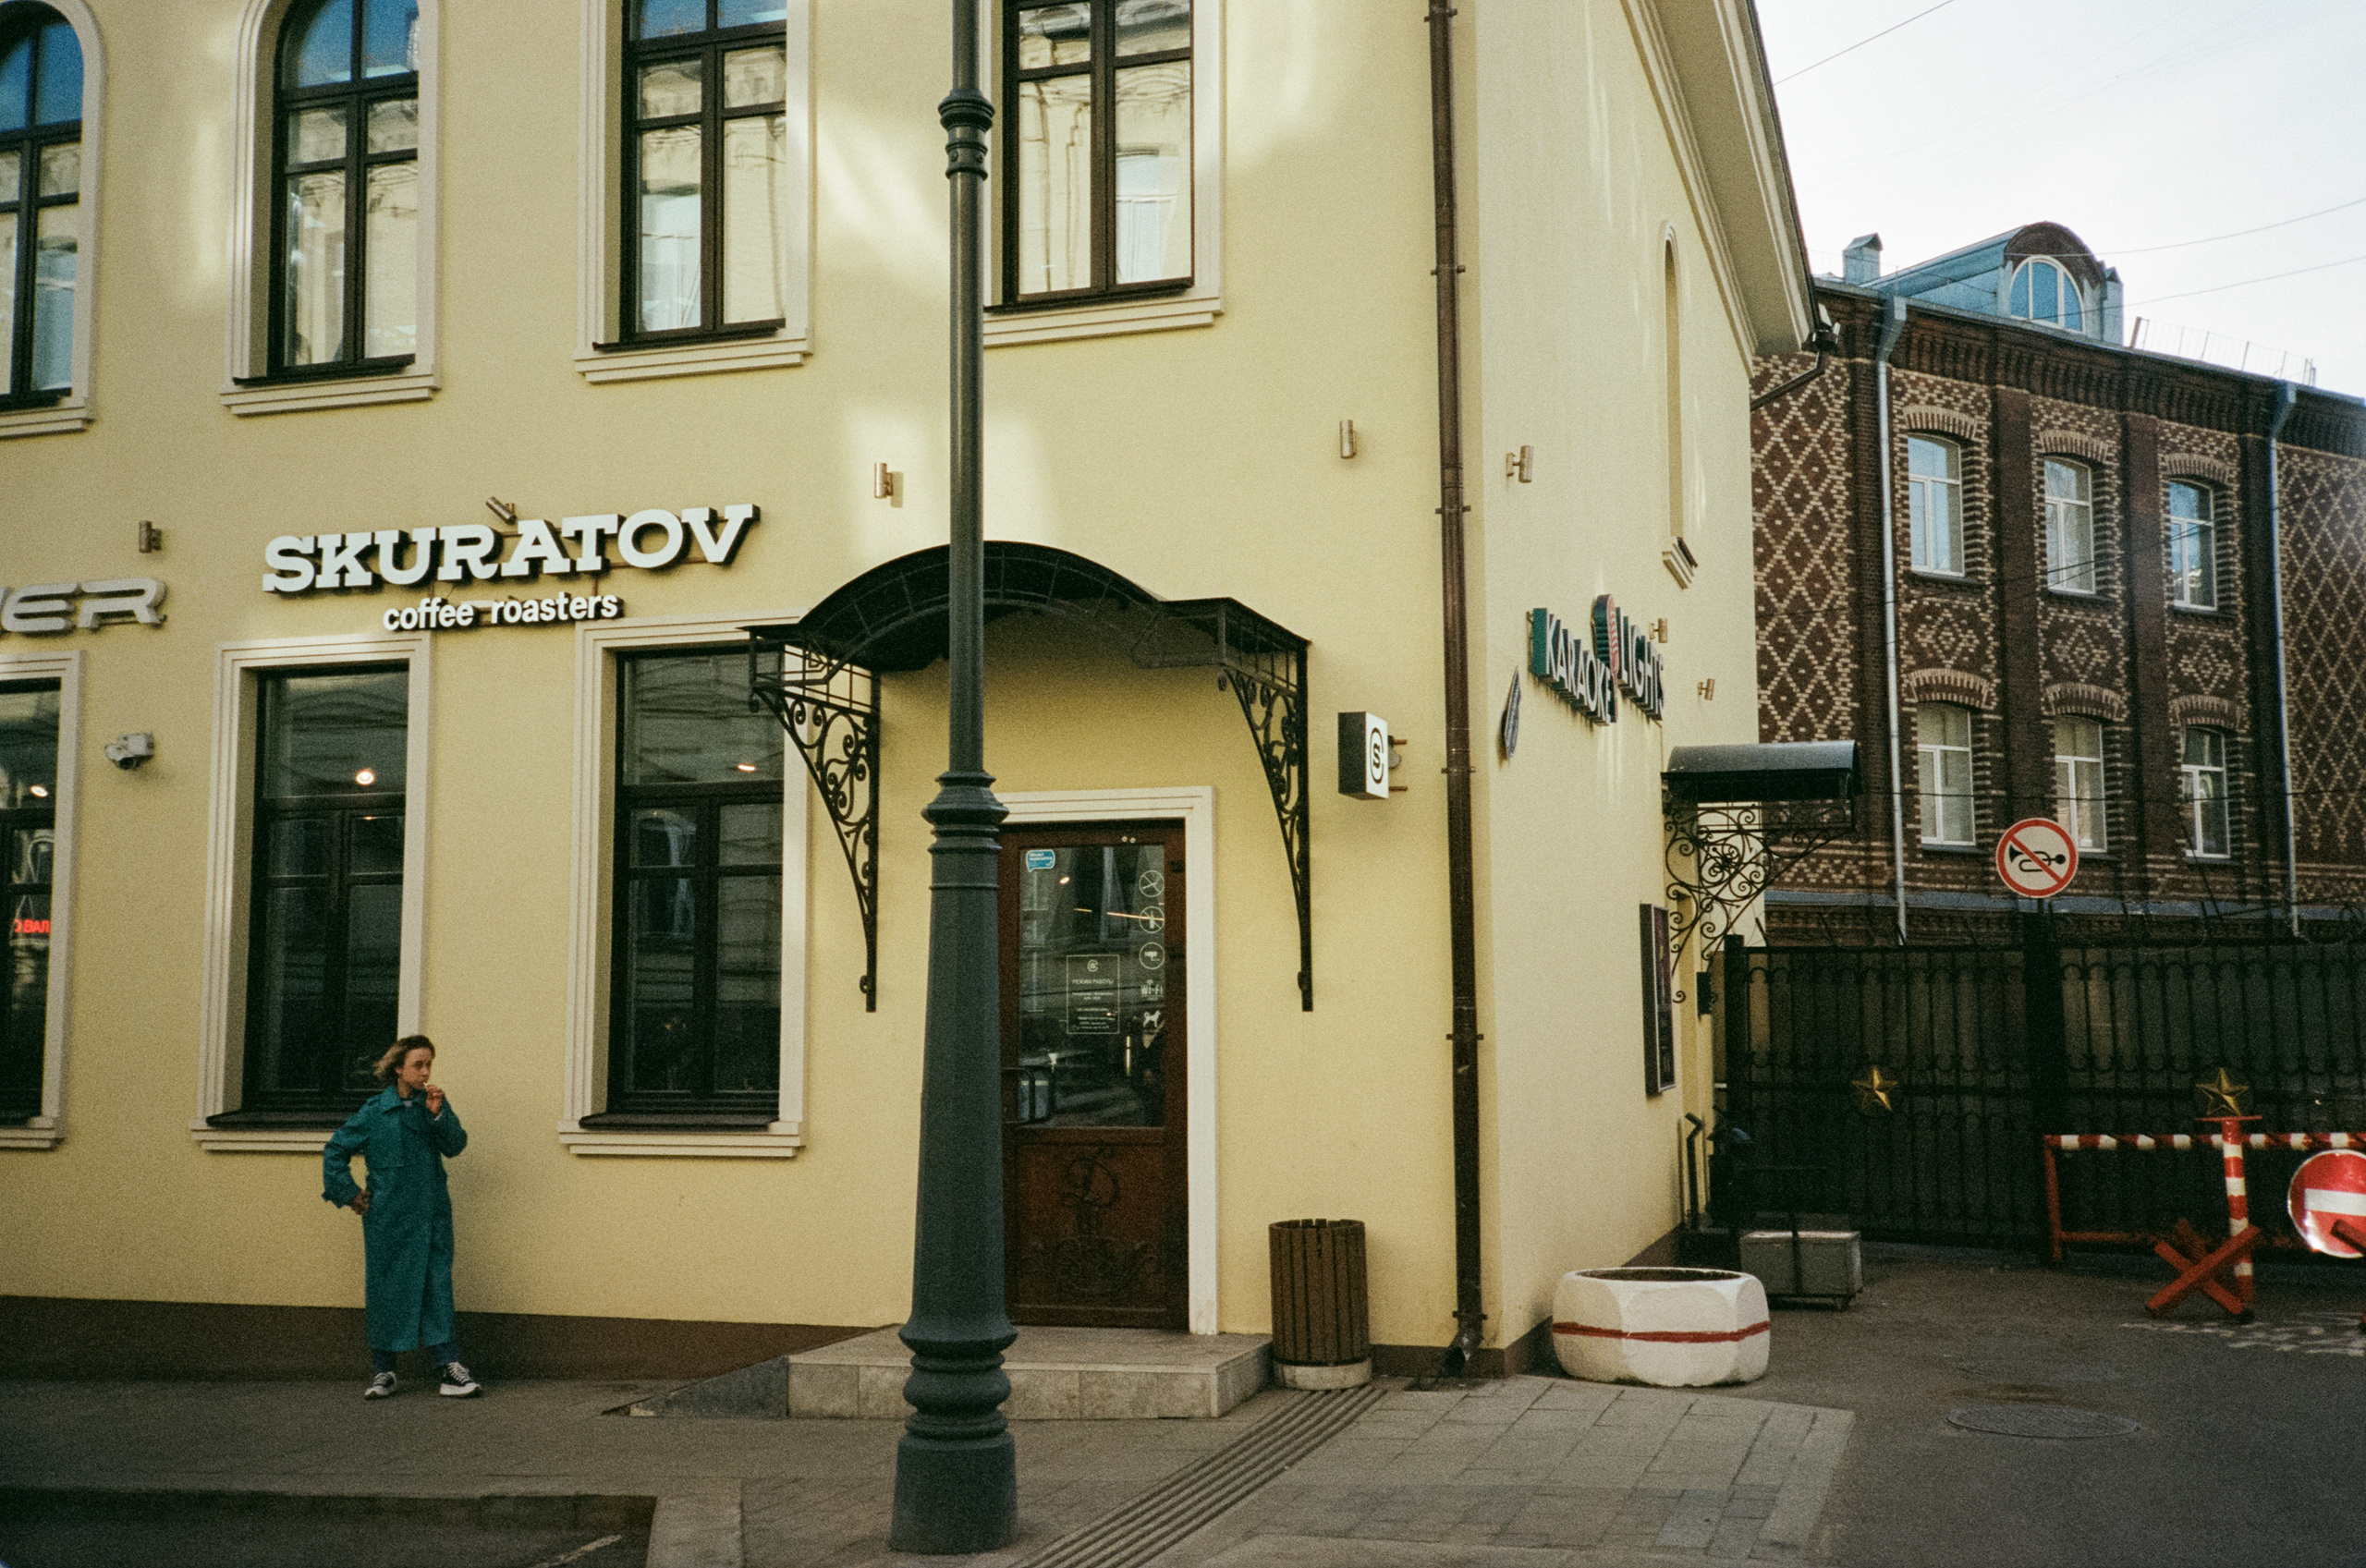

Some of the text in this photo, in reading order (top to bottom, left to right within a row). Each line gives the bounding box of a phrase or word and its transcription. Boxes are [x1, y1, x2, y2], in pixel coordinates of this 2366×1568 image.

[262, 504, 755, 592] SKURATOV
[0, 577, 161, 633] ER
[383, 591, 619, 631] coffee roasters
[1545, 610, 1612, 723] KARAOKE
